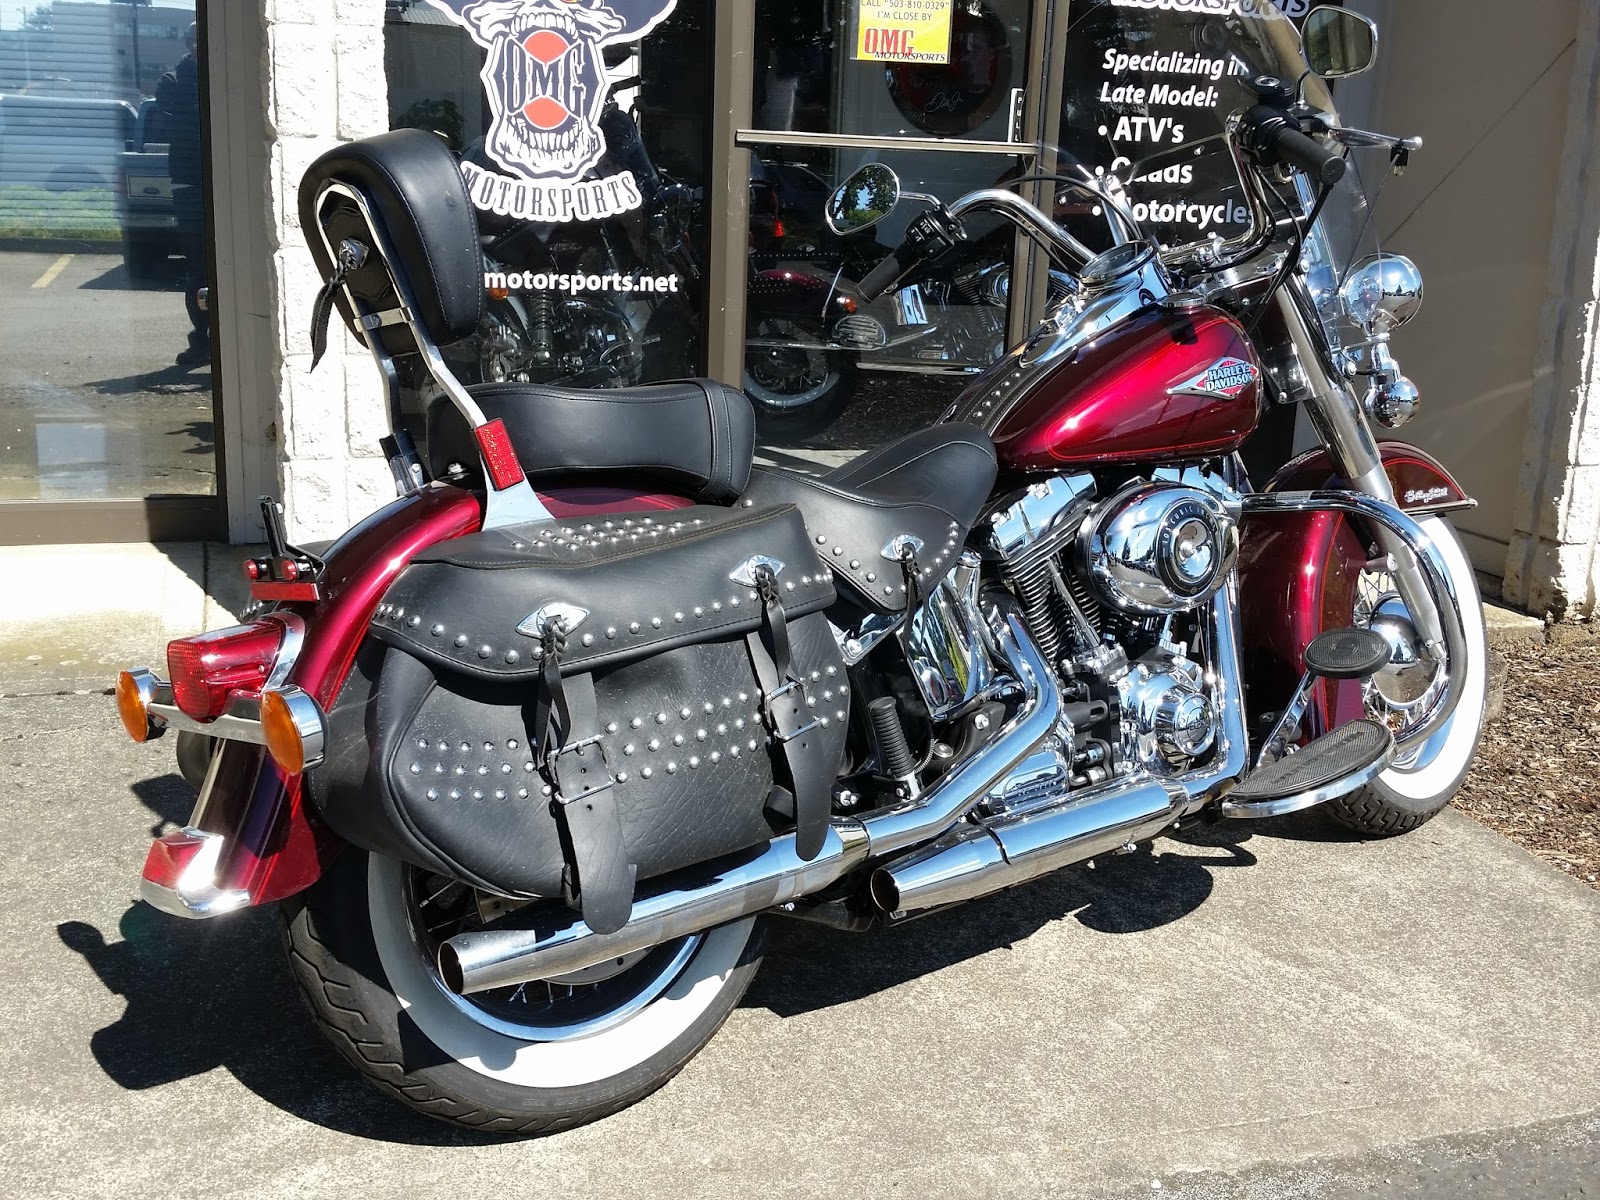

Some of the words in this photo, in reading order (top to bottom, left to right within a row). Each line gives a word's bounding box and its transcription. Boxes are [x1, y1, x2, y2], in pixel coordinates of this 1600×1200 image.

[893, 11, 919, 21] CLOSE
[922, 13, 933, 21] BY
[864, 28, 915, 56] OMG
[874, 51, 946, 62] MOTORSPORTS
[1102, 48, 1225, 81] Specializing
[503, 37, 588, 119] OMG
[1100, 81, 1146, 104] Late
[1148, 83, 1219, 108] Model:
[1112, 115, 1185, 144] ATV's
[464, 166, 638, 217] MOTORSPORTS
[1125, 198, 1252, 230] otorcycle
[484, 269, 679, 296] motorsports.net
[1205, 373, 1254, 392] DAVIDSON
